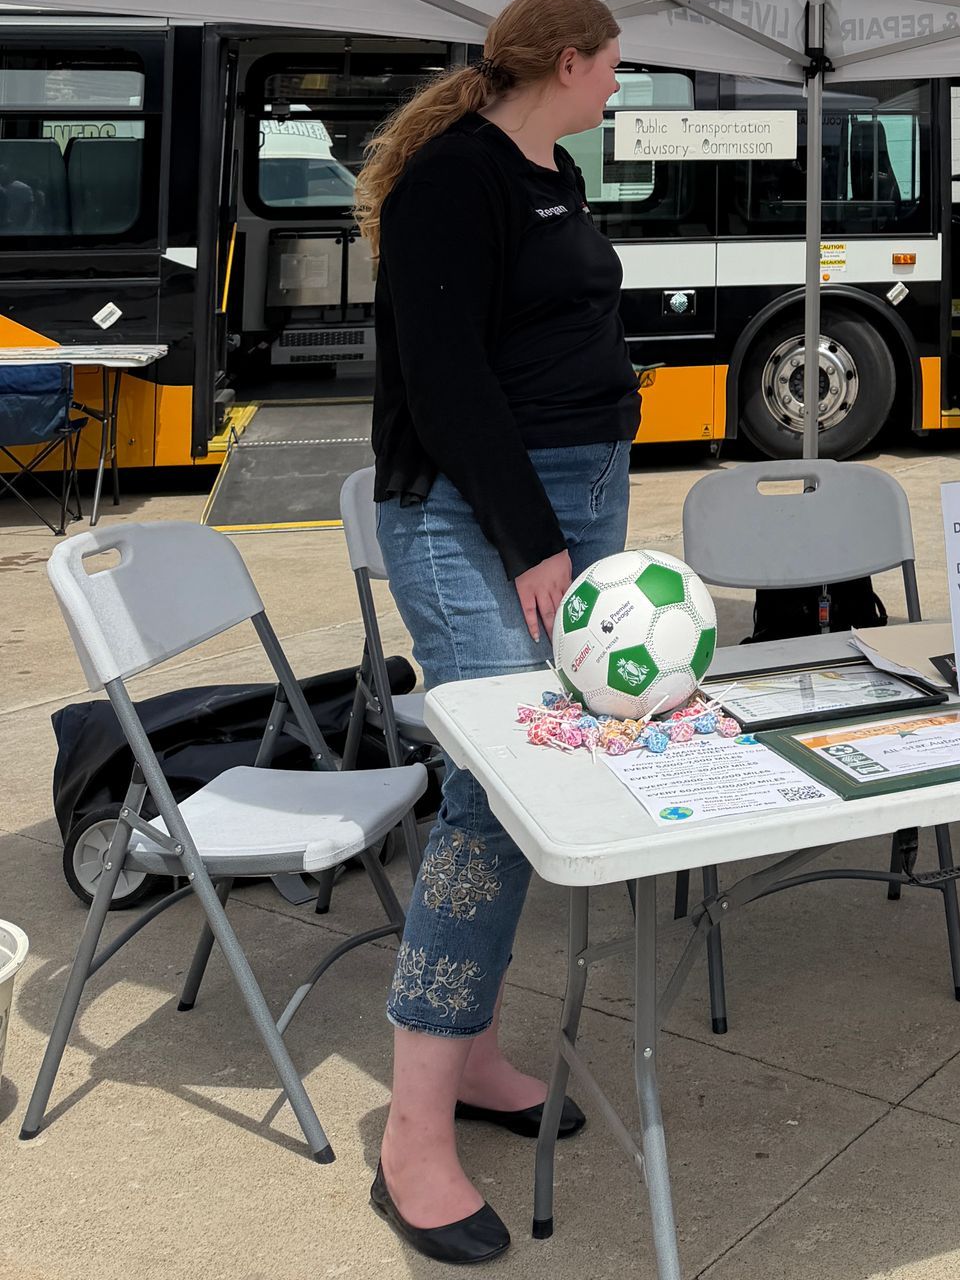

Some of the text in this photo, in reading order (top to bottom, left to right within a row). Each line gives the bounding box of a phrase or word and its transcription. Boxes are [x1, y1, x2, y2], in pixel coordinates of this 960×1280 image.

[636, 118, 771, 136] Public Transportation
[634, 139, 773, 157] Advisory Commission
[536, 205, 568, 218] Regan
[609, 600, 631, 620] Premier
[613, 604, 636, 626] League
[573, 642, 592, 669] Castrol
